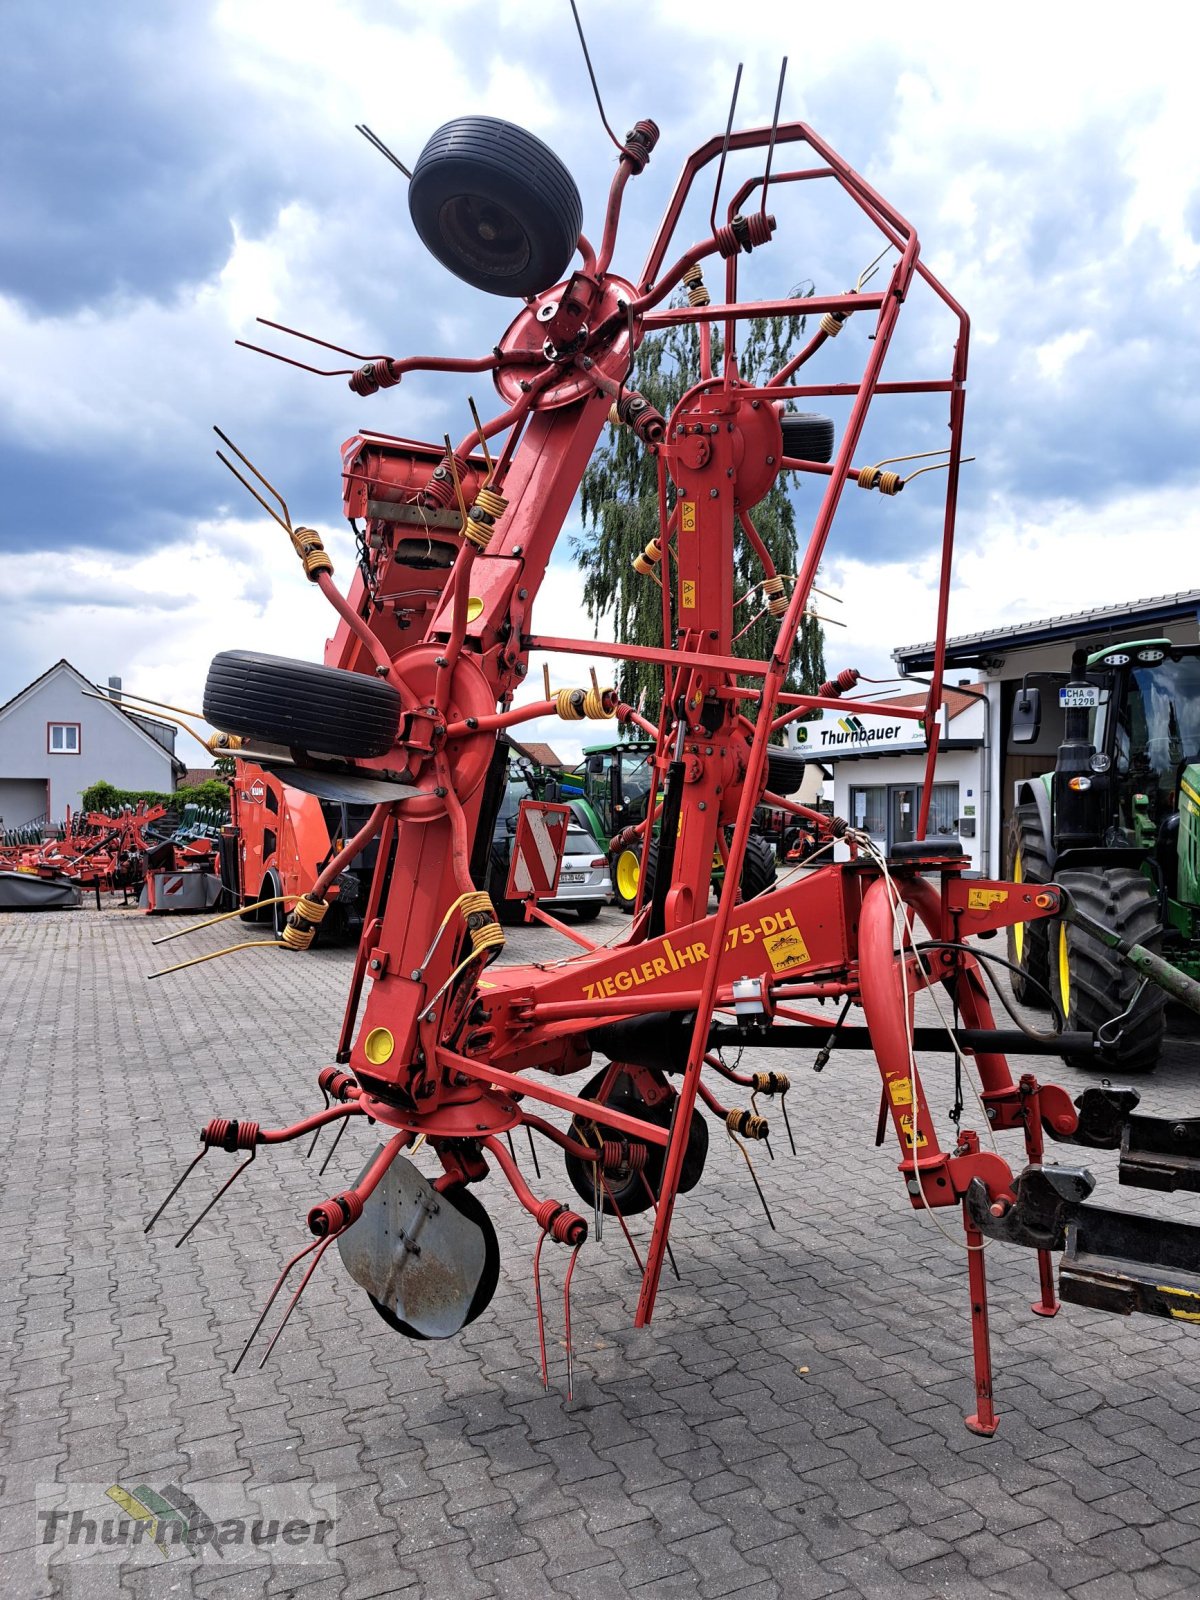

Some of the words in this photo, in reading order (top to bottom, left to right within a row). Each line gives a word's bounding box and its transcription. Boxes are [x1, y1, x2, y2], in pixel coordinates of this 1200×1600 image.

[1066, 690, 1084, 698] CHA
[1064, 698, 1070, 706] W
[1072, 698, 1095, 706] 1298
[820, 725, 902, 746] Thurnbauer
[582, 959, 671, 1000] ZIEGLER
[725, 908, 796, 953] 75-DH
